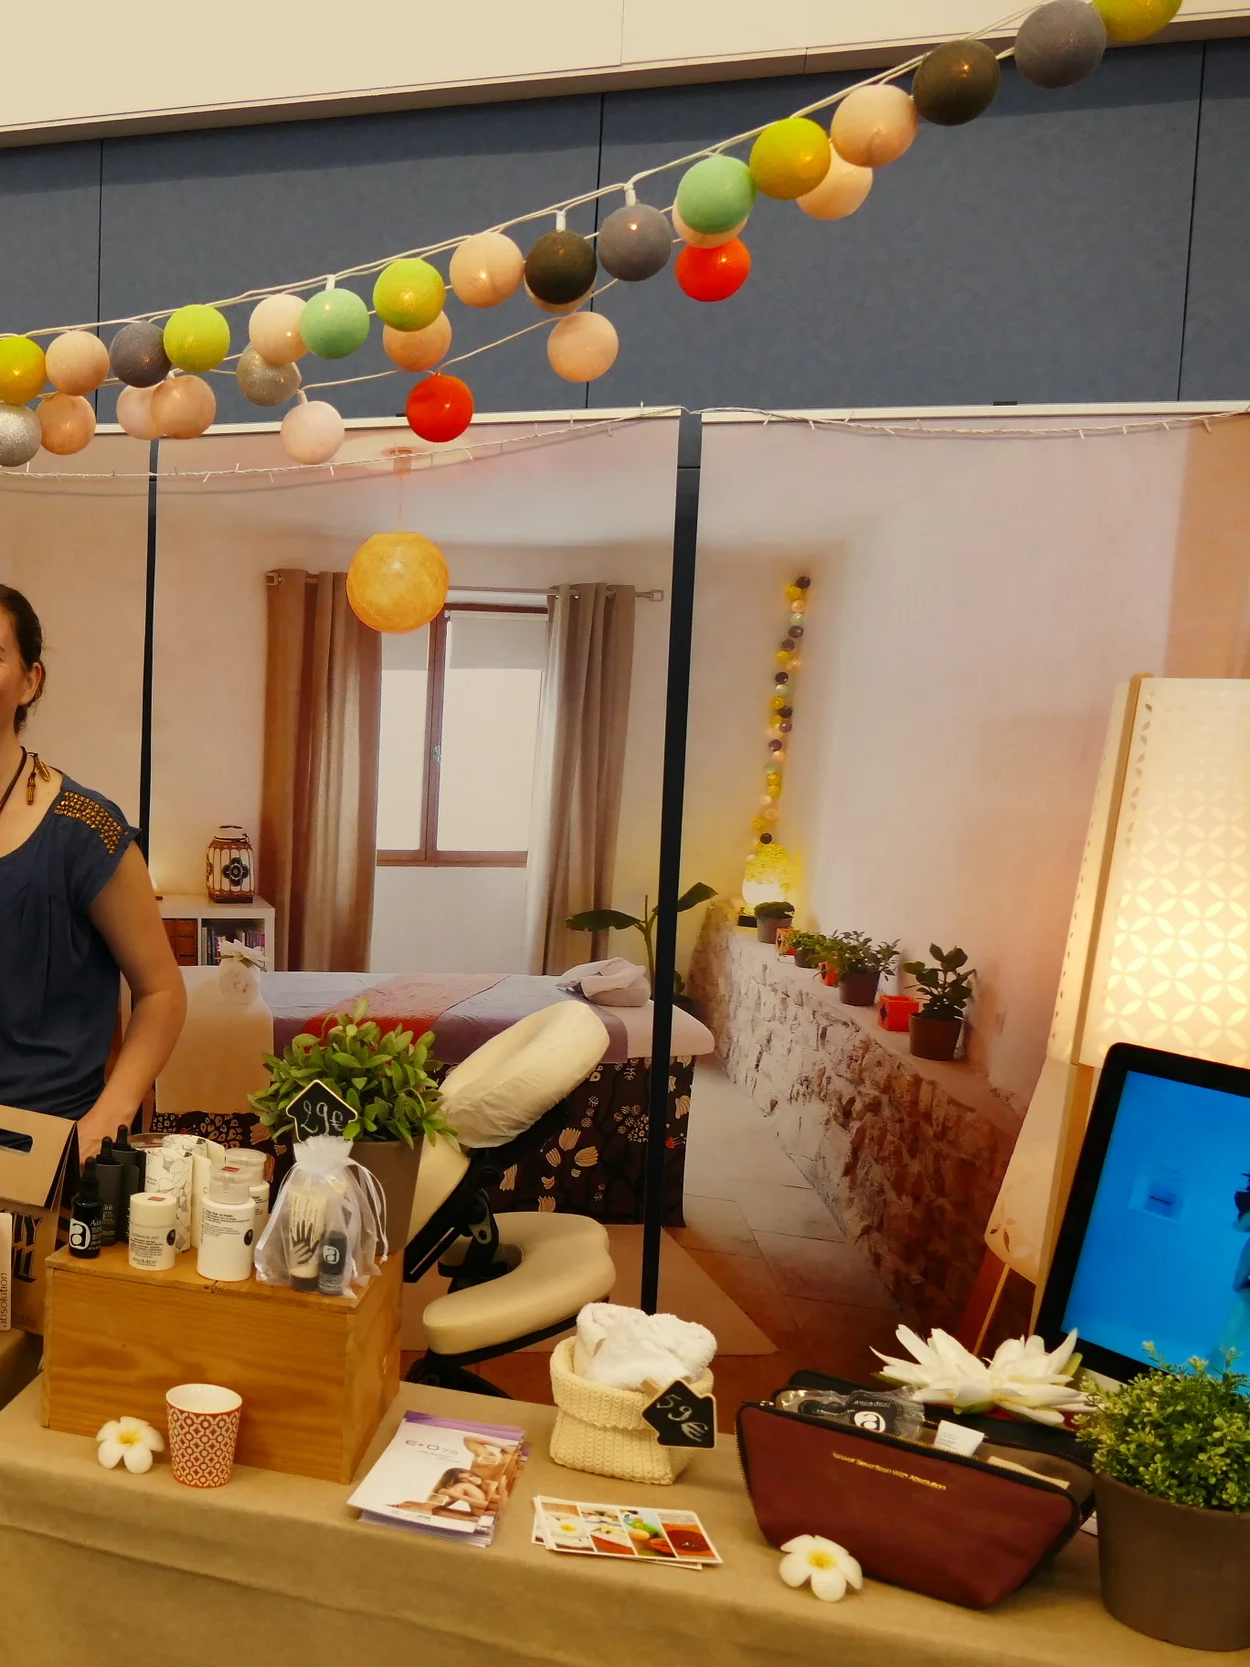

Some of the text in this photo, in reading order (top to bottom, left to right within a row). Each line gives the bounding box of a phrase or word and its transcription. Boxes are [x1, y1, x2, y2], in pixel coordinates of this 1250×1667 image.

[300, 1100, 344, 1137] 29€
[0, 1273, 7, 1328] absolution
[656, 1394, 709, 1443] 59€
